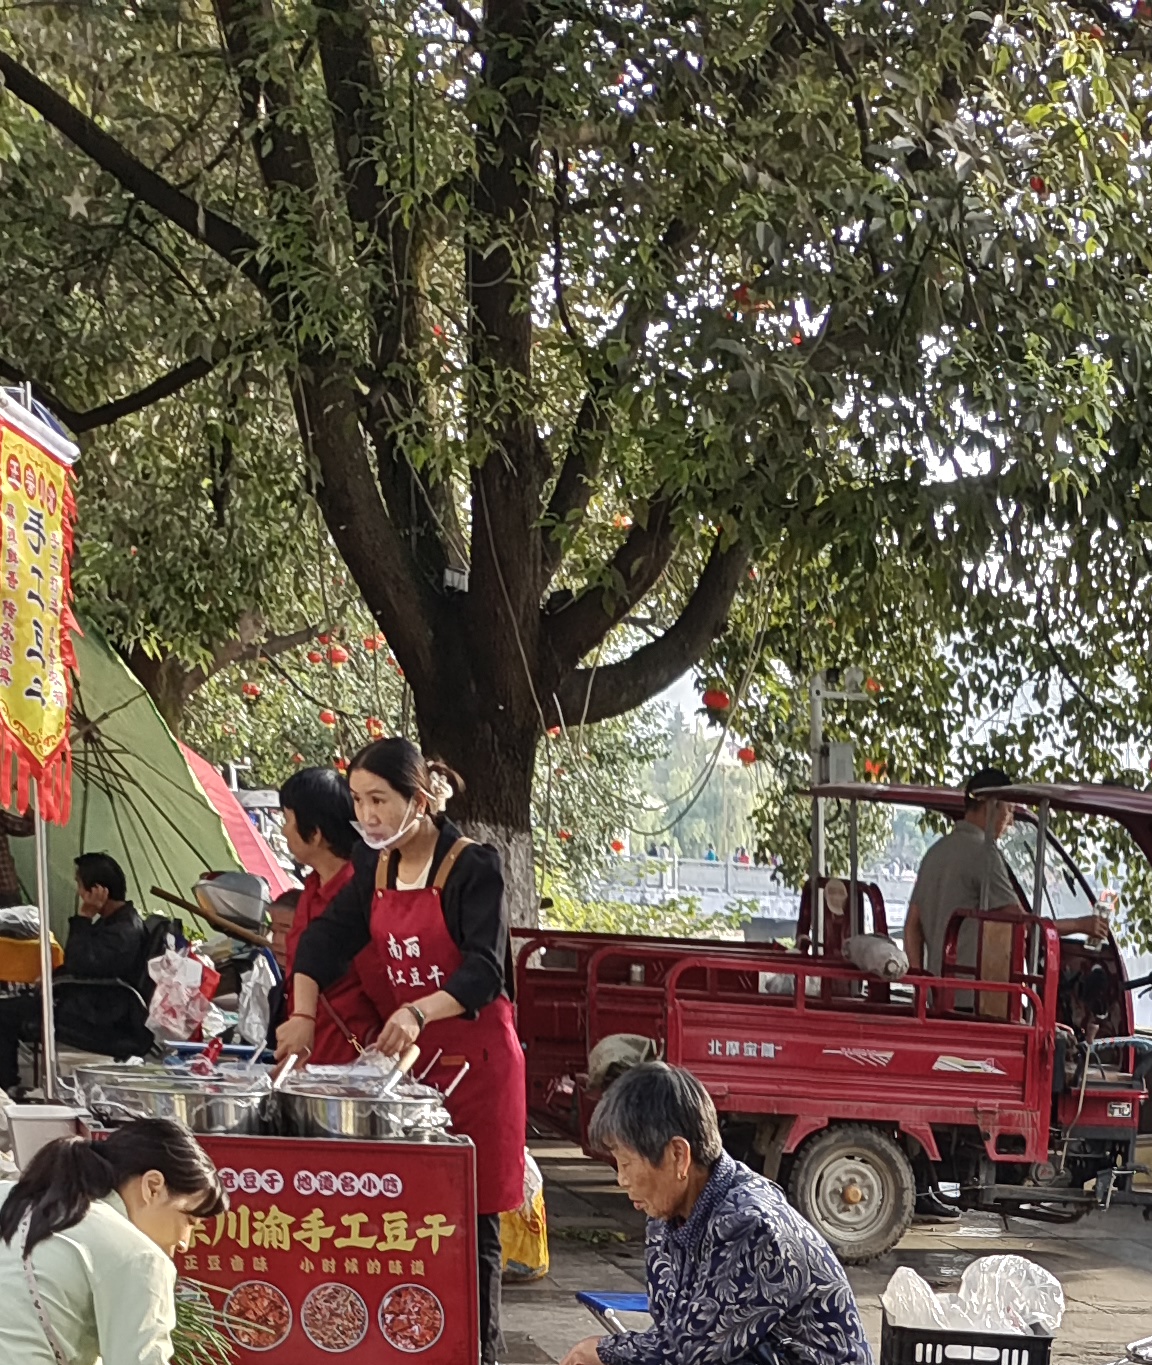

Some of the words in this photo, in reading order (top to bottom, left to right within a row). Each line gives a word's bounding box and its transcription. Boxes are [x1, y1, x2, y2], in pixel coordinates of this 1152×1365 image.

[299, 1256, 425, 1276] 小时候的味道
